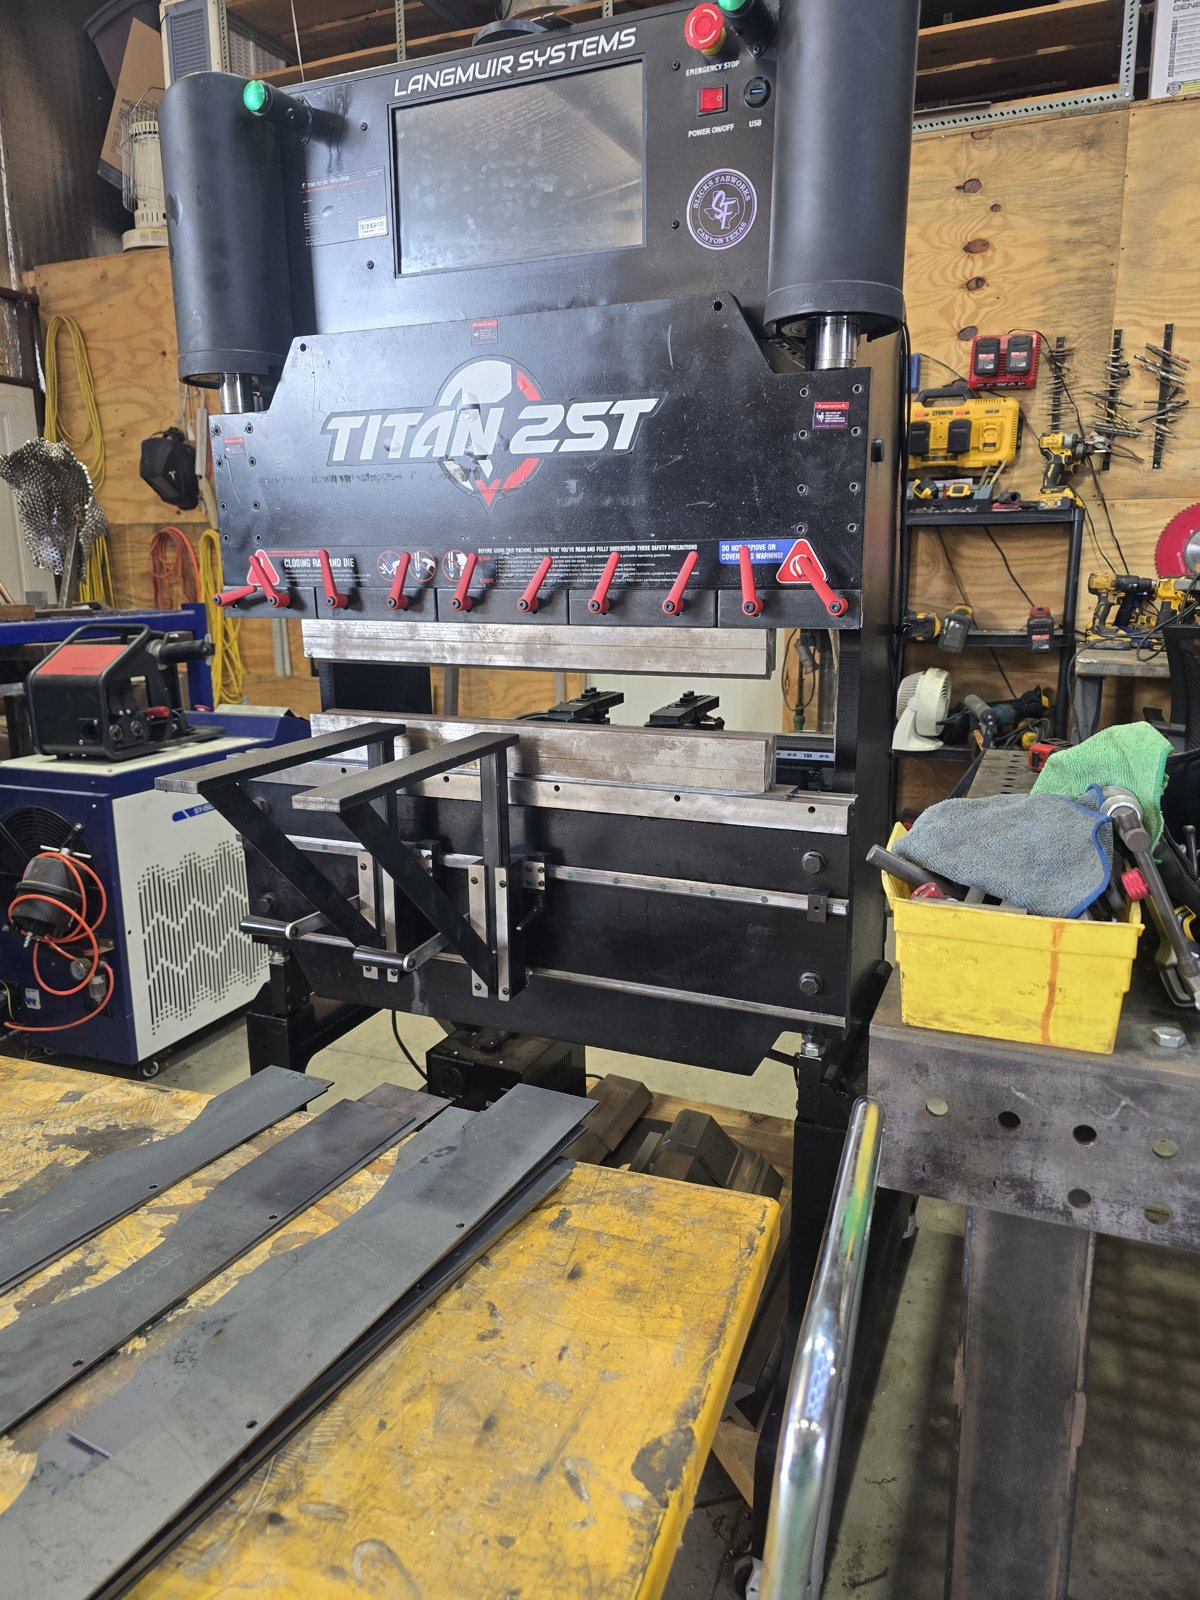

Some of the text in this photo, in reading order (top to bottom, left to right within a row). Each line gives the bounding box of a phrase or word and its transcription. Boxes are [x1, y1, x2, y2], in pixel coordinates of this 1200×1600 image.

[394, 27, 637, 97] LANGMUIR SYSTEMS
[686, 60, 740, 76] EMERGENCY STOP
[688, 123, 735, 138] POWER ON/OFF
[748, 119, 762, 128] USB
[693, 175, 751, 209] SLICKS FABWORKS
[697, 221, 747, 245] CANYON TEXAS
[327, 398, 660, 462] TITAN 2ST
[721, 544, 729, 552] DO
[747, 543, 766, 551] EMOVE
[768, 543, 776, 551] OR
[284, 558, 311, 568] CLOSING
[312, 558, 322, 568] RA
[343, 557, 354, 568] DIE
[721, 552, 740, 560] COVER
[755, 552, 783, 560] WARNING!
